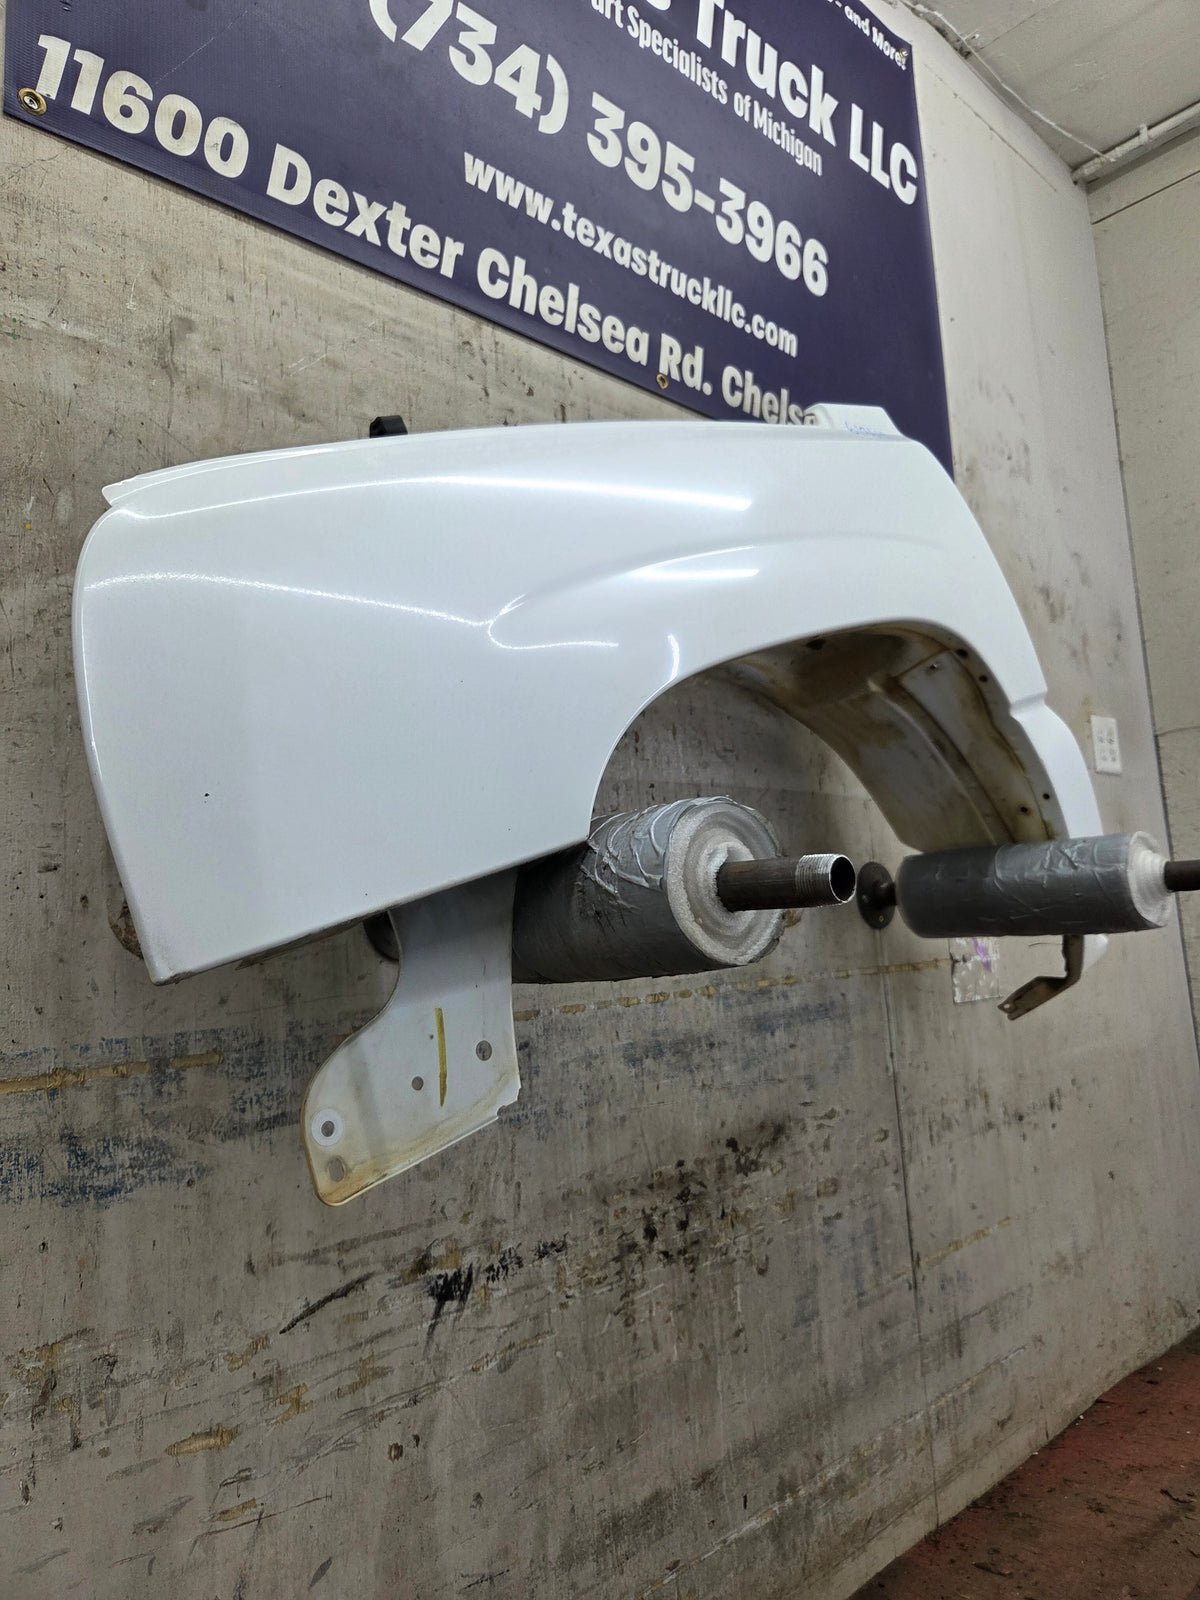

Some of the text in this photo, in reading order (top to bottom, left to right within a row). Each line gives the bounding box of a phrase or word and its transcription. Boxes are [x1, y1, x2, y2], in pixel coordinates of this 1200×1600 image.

[627, 5, 728, 105] Specialists
[733, 91, 752, 123] of
[753, 100, 823, 177] Michigan
[697, 0, 918, 205] Truck LLC
[844, 5, 871, 37] and
[37, 34, 250, 179] 11600
[266, 142, 465, 279] Dexter
[476, 247, 649, 366] Chelsea
[658, 332, 713, 396] Rd.
[369, 0, 828, 297] (734) 395-3966
[463, 151, 798, 358] www.texastruckllc.com
